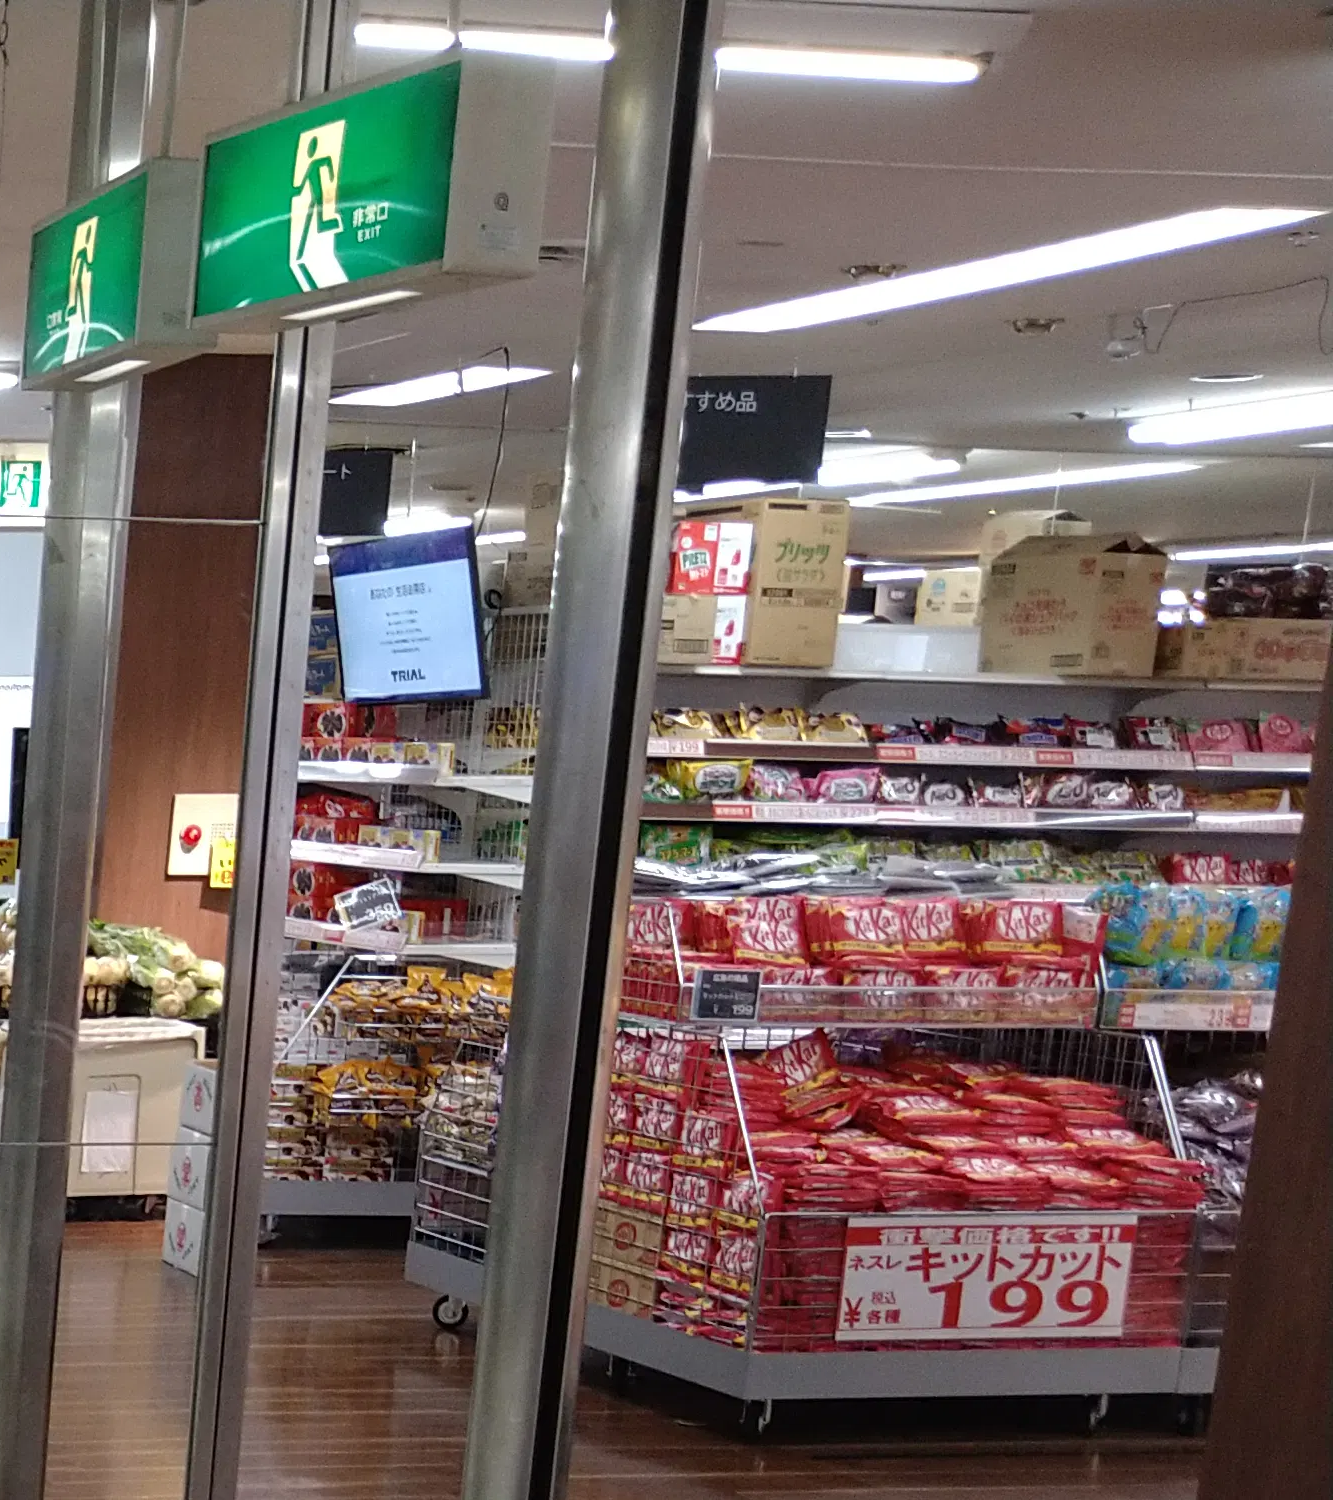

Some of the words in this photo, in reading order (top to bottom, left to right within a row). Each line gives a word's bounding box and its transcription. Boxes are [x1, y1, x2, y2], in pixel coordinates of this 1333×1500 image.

[351, 201, 389, 226] 非常口
[357, 224, 382, 242] EXIT
[390, 668, 426, 682] TRIAL
[849, 1254, 902, 1271] ネスレ
[905, 1245, 1123, 1283] キットカット
[843, 1296, 864, 1328] ¥
[867, 1309, 901, 1324] 各種
[928, 1279, 1109, 1328] 199
[871, 1291, 896, 1305] 税込
